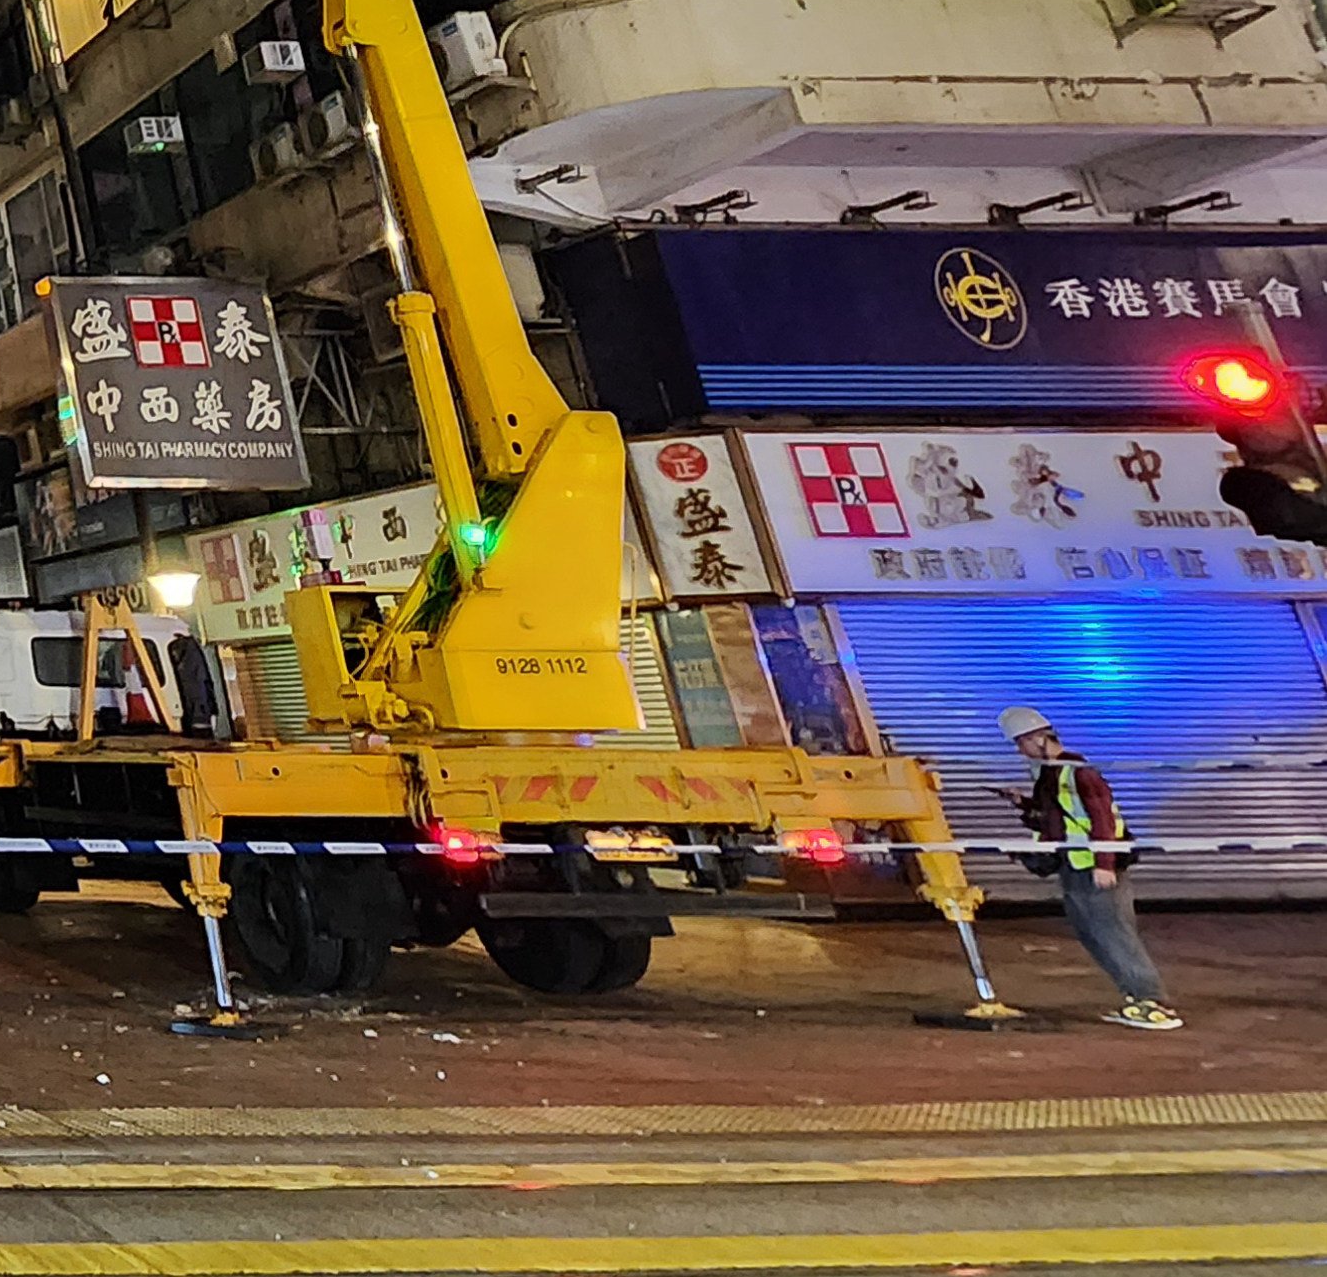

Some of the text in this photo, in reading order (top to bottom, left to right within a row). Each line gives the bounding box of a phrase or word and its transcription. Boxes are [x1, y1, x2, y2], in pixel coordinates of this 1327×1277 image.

[1045, 276, 1302, 319] 香港賽馬會
[93, 442, 294, 459] SHING TAI PHARMACY COMPANY
[1136, 509, 1247, 528] SHING TA
[674, 487, 744, 589] 盛泰
[346, 558, 377, 580] HING
[495, 657, 588, 674] 9128 1112
